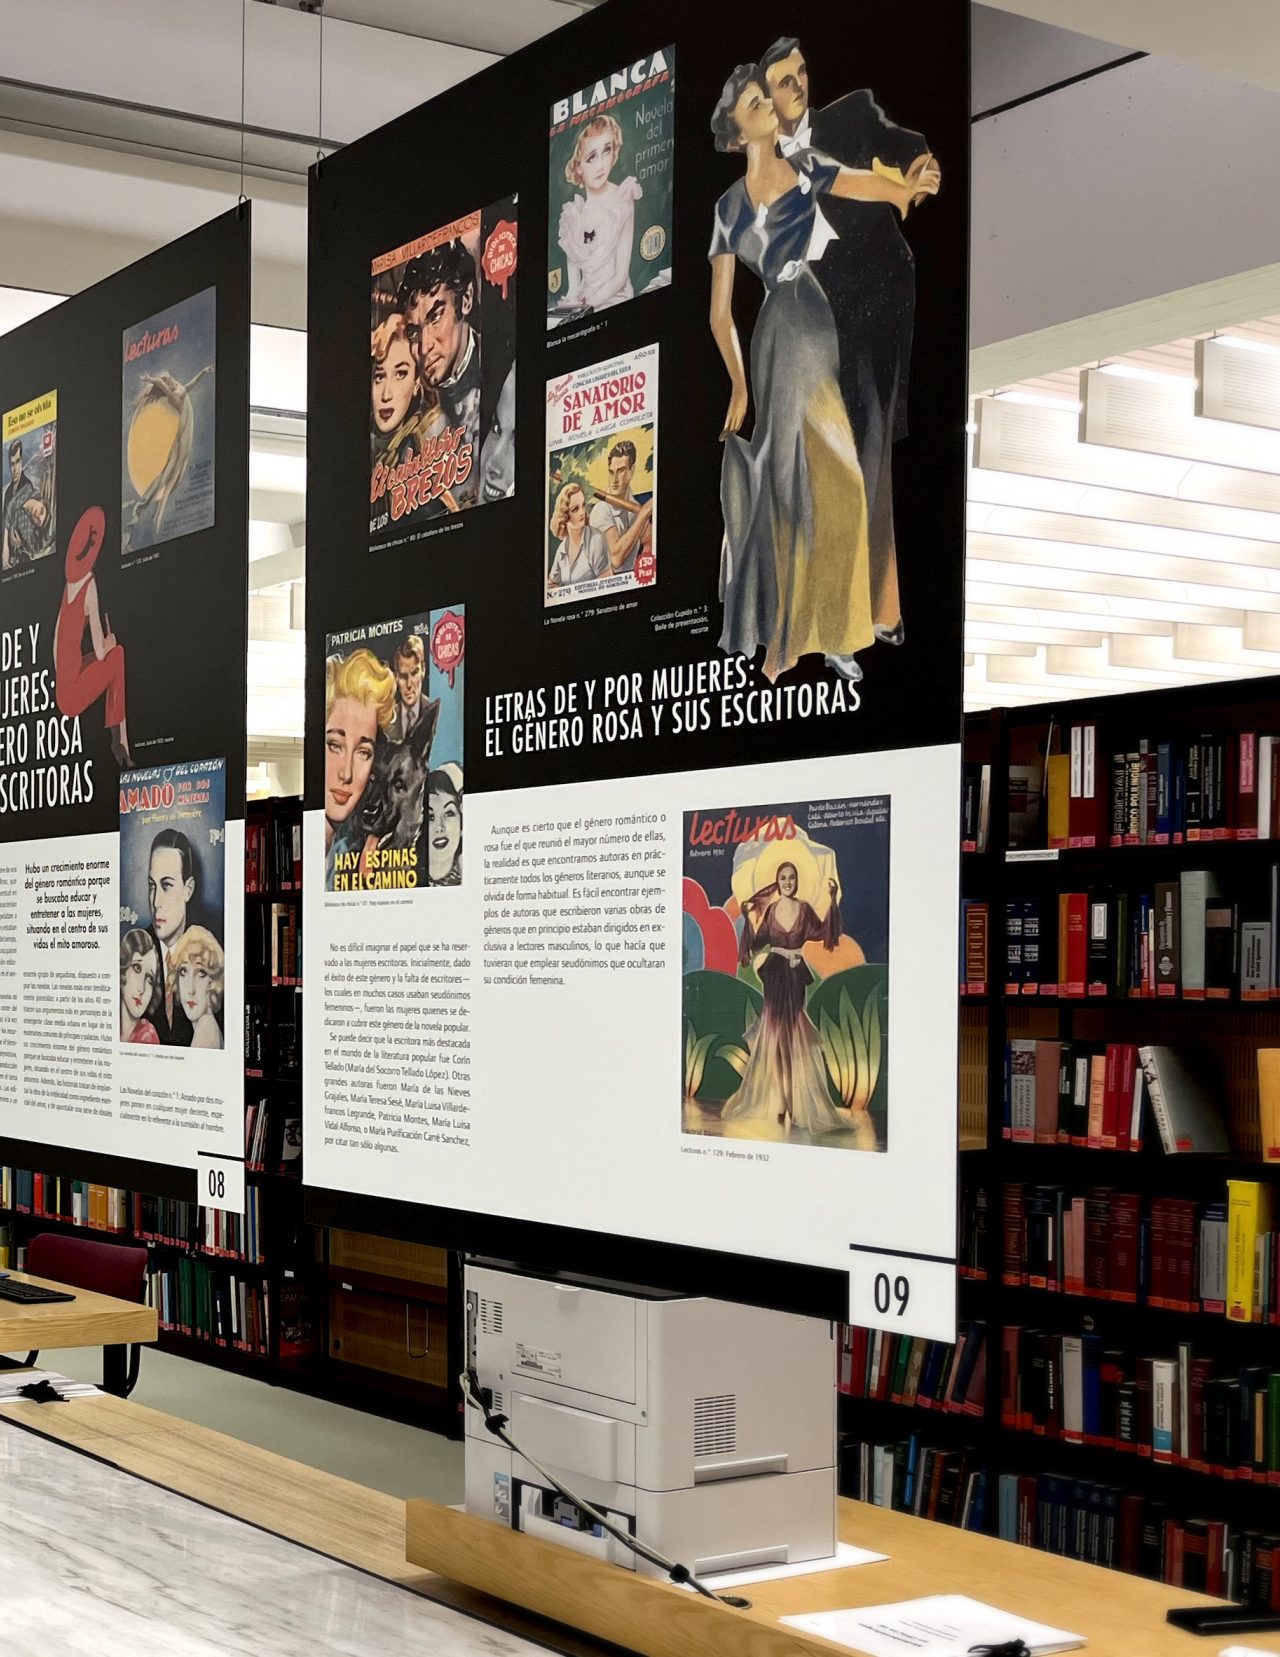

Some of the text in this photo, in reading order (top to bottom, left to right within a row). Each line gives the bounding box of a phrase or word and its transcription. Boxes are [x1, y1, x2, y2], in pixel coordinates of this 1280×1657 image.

[553, 50, 668, 125] BLANCA
[635, 97, 673, 128] Novela
[646, 119, 662, 141] del
[640, 158, 669, 180] amor
[401, 213, 480, 260] VILLARDEFRANCOS
[489, 251, 514, 275] CHICAS
[563, 371, 646, 412] SANATORIO
[563, 392, 645, 433] DE AMOR
[568, 430, 592, 442] NOVELA
[596, 423, 617, 434] LARGA
[620, 412, 653, 427] COMPLETA
[390, 443, 473, 522] BREZOS
[550, 615, 565, 625] Novela
[596, 605, 618, 615] Sanatorio
[619, 603, 625, 611] de
[626, 601, 639, 609] amor
[331, 619, 404, 647] PATRICIA MONTES
[435, 621, 463, 645] BIBLIOTECA
[2, 628, 22, 672] DE
[29, 623, 39, 664] Y
[437, 642, 460, 660] CHICAS
[486, 655, 755, 726] LETRAS DE Y POR MUJERES:
[486, 679, 861, 757] EL GÉNERO ROSA Y SUS ESCRITORAS
[36, 715, 83, 760] ROSA
[131, 769, 161, 782] NOVELAS
[175, 764, 188, 776] DEL
[190, 759, 223, 773] CORAZÓN
[1127, 762, 1140, 807] POLILINGÜE
[119, 783, 174, 814] AMADO
[490, 812, 666, 837] Aunque es cierto que el género romántico o
[483, 830, 665, 852] rosa fue el que reunió el mayor número de ellas,
[25, 862, 40, 874] Hubo
[50, 860, 85, 872] crecimiento
[86, 860, 110, 869] enorme
[334, 847, 418, 871] HAY ESPINAS
[483, 848, 665, 868] la realidad es que encontramos autoras en prác-
[334, 869, 418, 892] EN EL CAMINO
[333, 1048, 339, 1056] el
[340, 1048, 362, 1058] mundo
[363, 1050, 371, 1058] de
[373, 1050, 379, 1060] la
[380, 1051, 409, 1062] literatura
[411, 1053, 436, 1064] popular
[438, 1054, 450, 1064] fue
[324, 1062, 344, 1072] Tellado
[365, 1065, 375, 1074] del
[375, 1066, 400, 1076] Socorro
[401, 1068, 424, 1078] Tellado
[451, 1071, 470, 1080] Otras
[680, 1146, 702, 1155] Lecturas
[725, 1149, 746, 1159] Febrero
[747, 1151, 754, 1160] de
[755, 1153, 769, 1161] 1932
[208, 1169, 225, 1198] 08
[874, 1272, 910, 1316] 09
